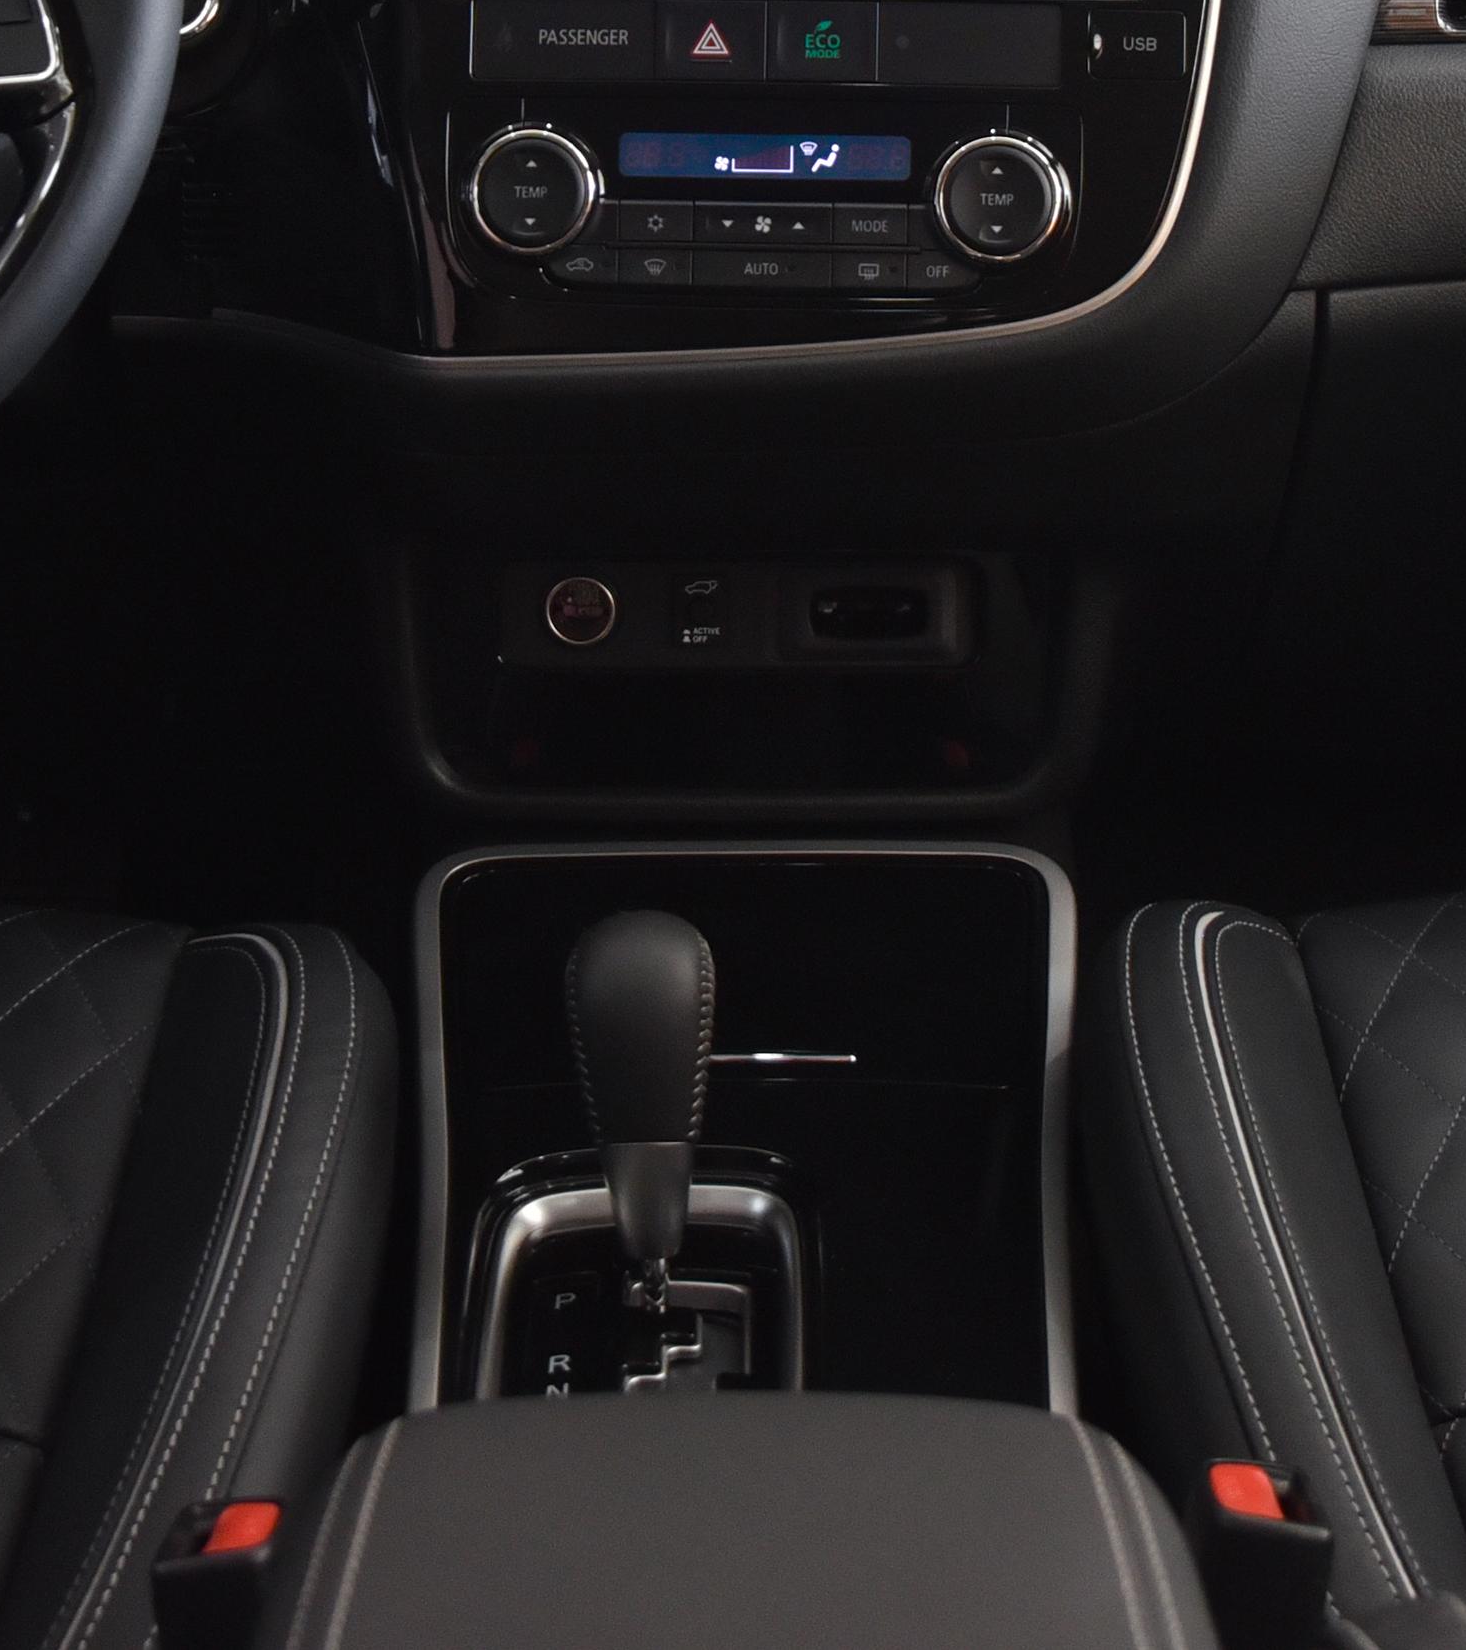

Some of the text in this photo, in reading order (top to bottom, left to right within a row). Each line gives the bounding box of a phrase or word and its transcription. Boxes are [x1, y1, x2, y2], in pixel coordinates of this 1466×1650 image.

[538, 27, 629, 47] PASSENGER
[804, 33, 841, 49] ECO
[1123, 37, 1158, 52] USB
[804, 49, 841, 60] MODE
[514, 185, 548, 199] TEMP
[979, 192, 1014, 207] TEMP
[851, 218, 889, 234] MODE
[744, 262, 779, 276] AUTO
[926, 265, 950, 279] OFF
[693, 626, 720, 635] ACTIVE
[692, 635, 708, 644] OFF
[555, 1292, 576, 1310] P
[548, 1354, 570, 1374] R
[546, 1382, 569, 1397] N
